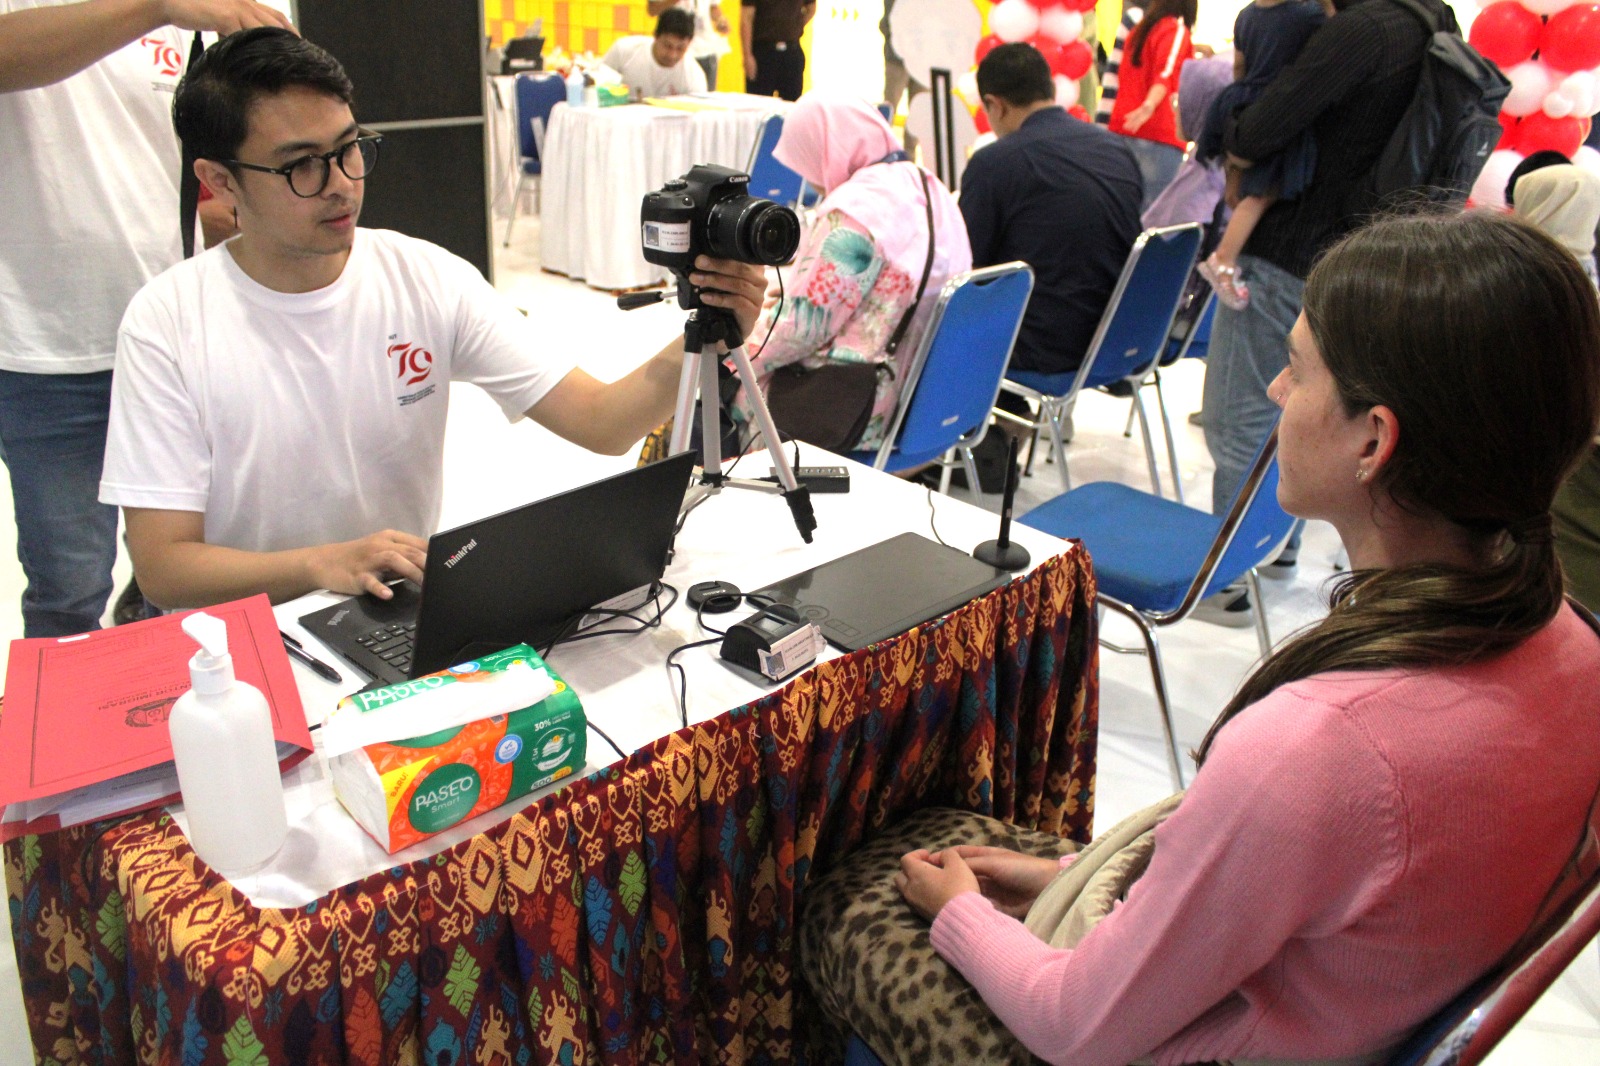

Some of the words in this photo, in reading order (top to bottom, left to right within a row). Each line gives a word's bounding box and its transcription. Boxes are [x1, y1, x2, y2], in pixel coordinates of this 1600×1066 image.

[387, 341, 433, 386] 79
[444, 538, 477, 568] ThinkPad
[358, 676, 443, 710] PASEO
[534, 718, 552, 732] 30%
[390, 771, 409, 798] BARU!
[415, 776, 473, 811] PASEO
